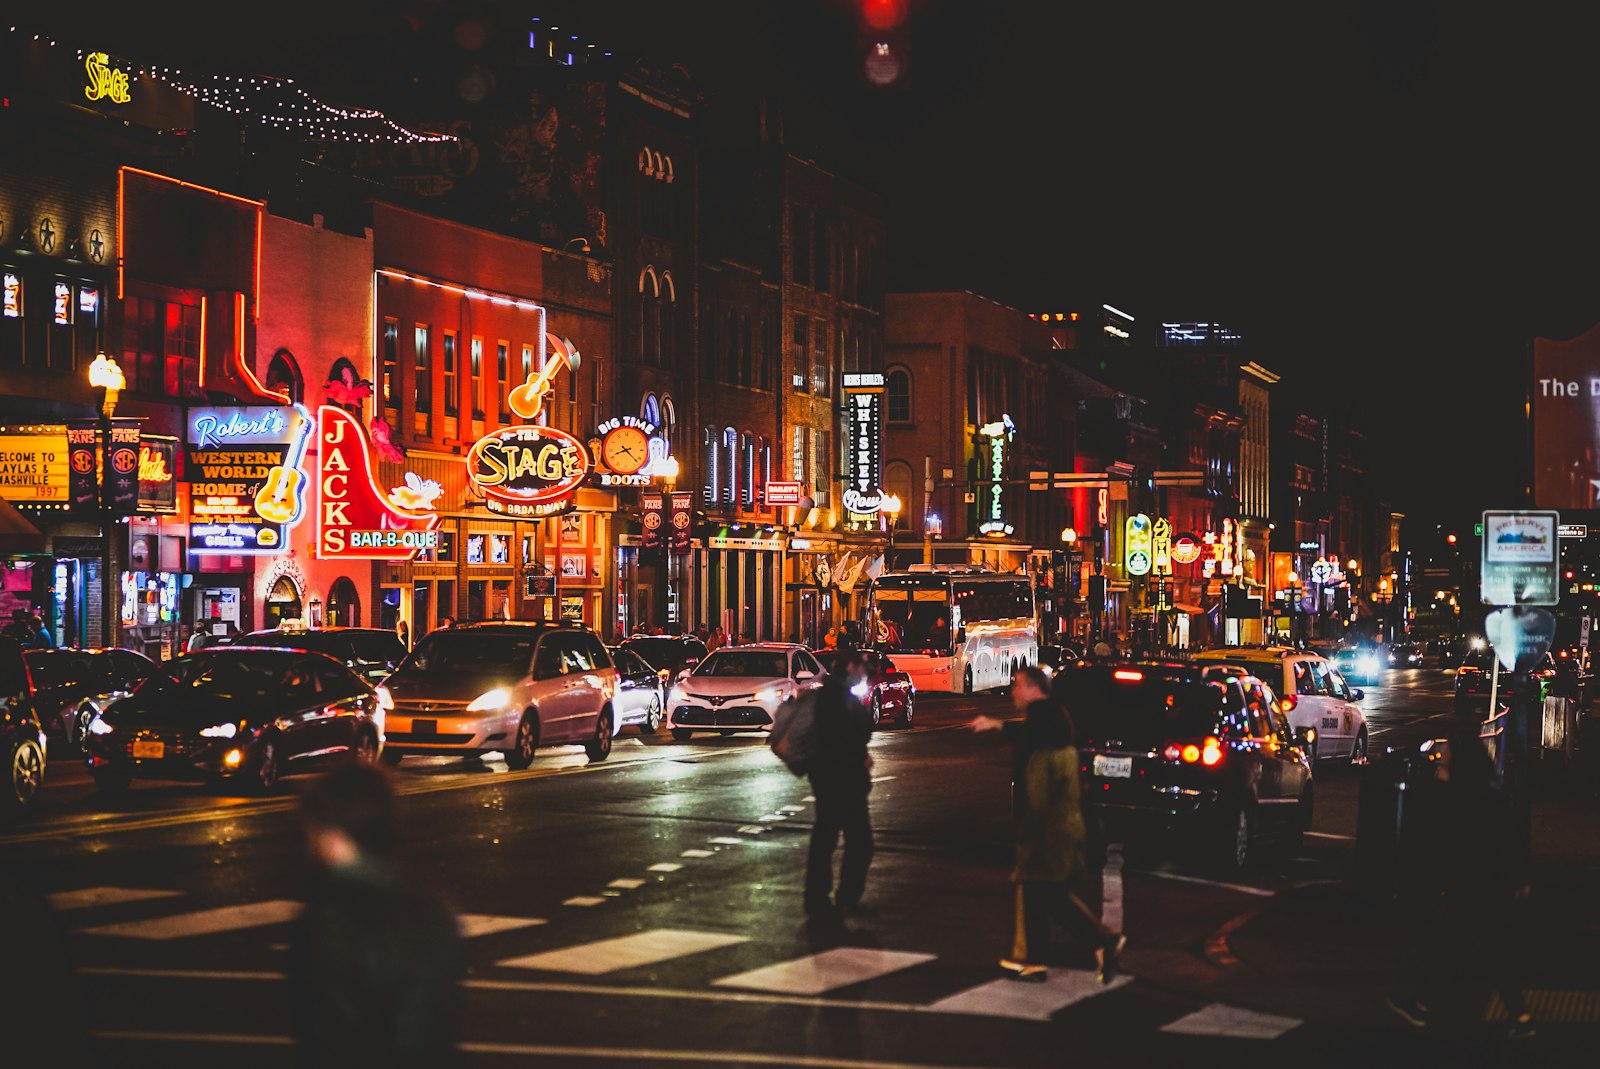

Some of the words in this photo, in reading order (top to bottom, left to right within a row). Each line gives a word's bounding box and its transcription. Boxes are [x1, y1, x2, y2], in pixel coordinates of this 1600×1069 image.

[85, 53, 131, 103] STAGE
[1539, 378, 1580, 397] The
[194, 409, 286, 448] Robert's
[598, 417, 620, 434] BIG
[622, 416, 654, 434] TIME
[68, 434, 95, 444] FANS
[112, 433, 140, 443] FANS
[516, 429, 540, 441] THE
[855, 394, 873, 492] WHISKEY
[42, 452, 55, 462] TO
[74, 452, 91, 472] SEC
[115, 451, 134, 472] SEC
[190, 451, 282, 465] WESTERN
[475, 438, 585, 486] STAGE
[43, 464, 48, 473] &
[202, 466, 269, 479] WORLD
[322, 419, 352, 552] JACKS
[601, 474, 651, 485] BOOTS
[35, 486, 58, 496] 1997
[191, 483, 247, 496] HOME
[248, 482, 260, 498] of
[487, 500, 503, 512] ON
[507, 500, 567, 515] BROADWAY
[672, 501, 690, 509] FANS
[845, 489, 881, 511] Row
[350, 531, 437, 548] BAR-B-QUE
